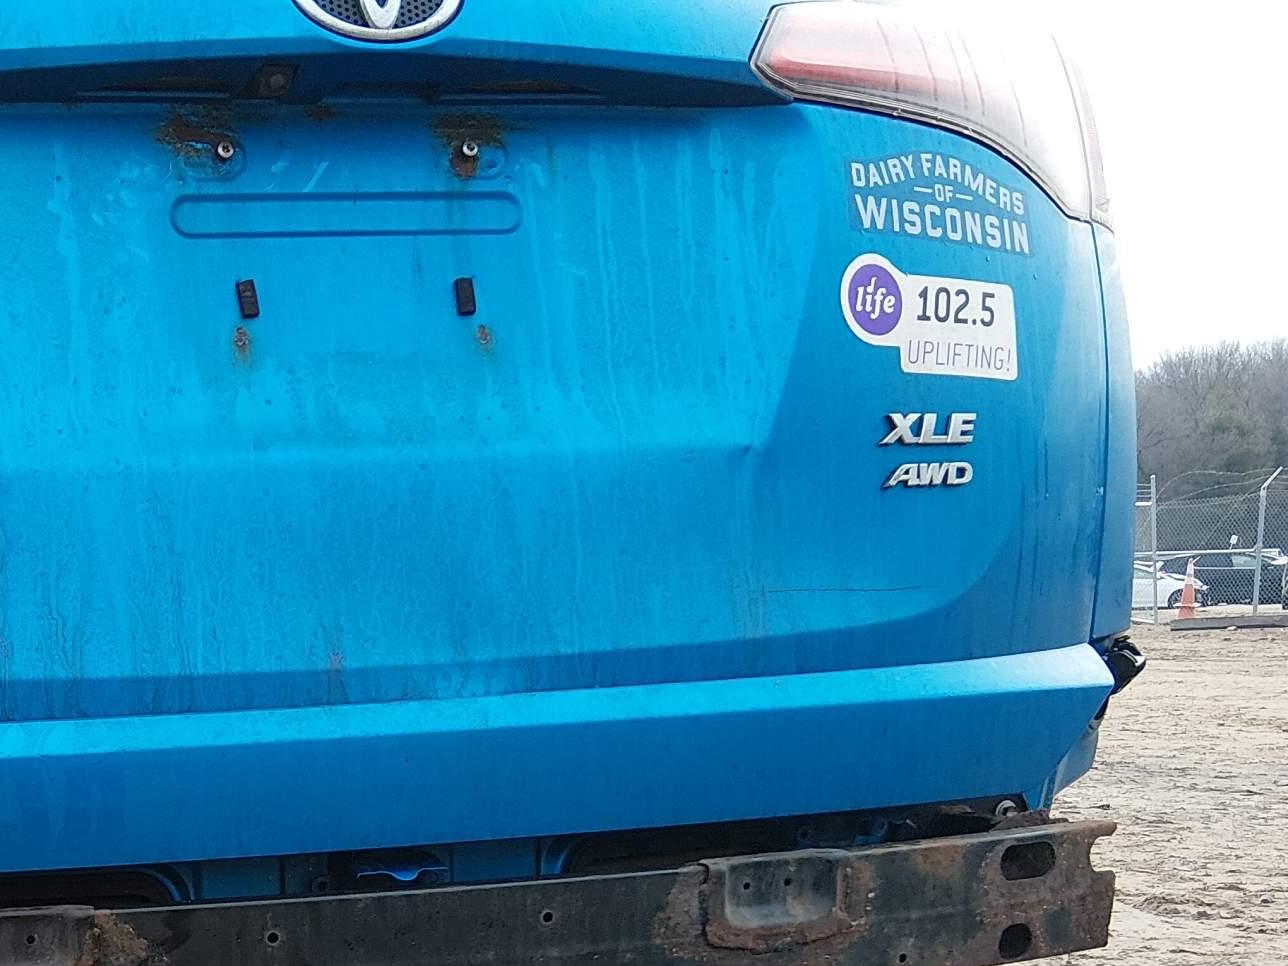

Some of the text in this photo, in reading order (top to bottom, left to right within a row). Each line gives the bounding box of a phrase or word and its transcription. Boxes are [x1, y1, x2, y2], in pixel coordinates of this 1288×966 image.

[851, 153, 1025, 215] DAIRY FARMERS
[934, 185, 954, 203] OF
[854, 194, 1030, 254] WISCONSIN
[855, 276, 896, 319] life
[916, 286, 996, 327] 102.5
[907, 339, 1012, 372] UPLIFTING!
[878, 412, 977, 444] XLE
[882, 462, 974, 487] AWD
